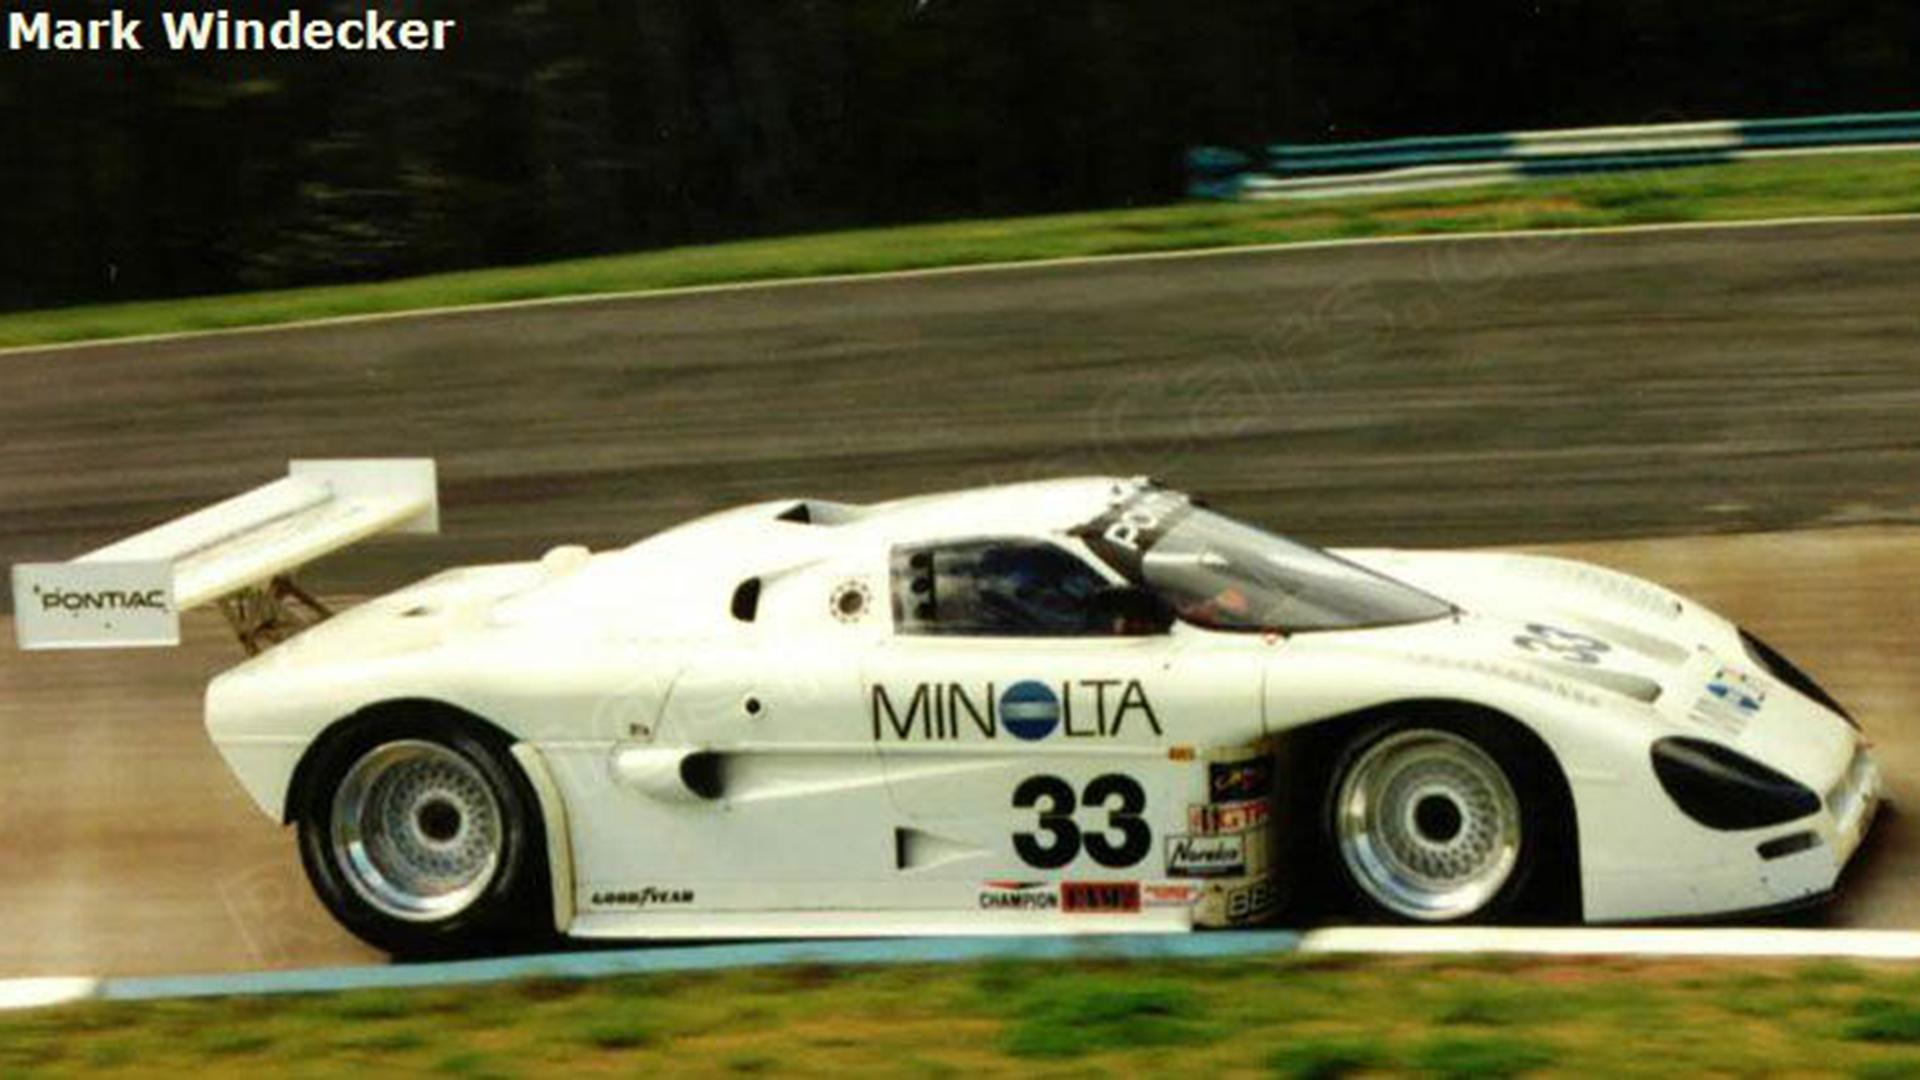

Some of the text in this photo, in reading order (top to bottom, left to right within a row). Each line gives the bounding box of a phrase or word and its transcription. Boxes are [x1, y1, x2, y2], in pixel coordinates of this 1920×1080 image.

[41, 588, 166, 611] PONTIAC
[1512, 623, 1612, 664] 33
[872, 680, 1163, 741] MINOLTA
[1011, 773, 1152, 870] 33
[979, 891, 1059, 909] CHAMPION
